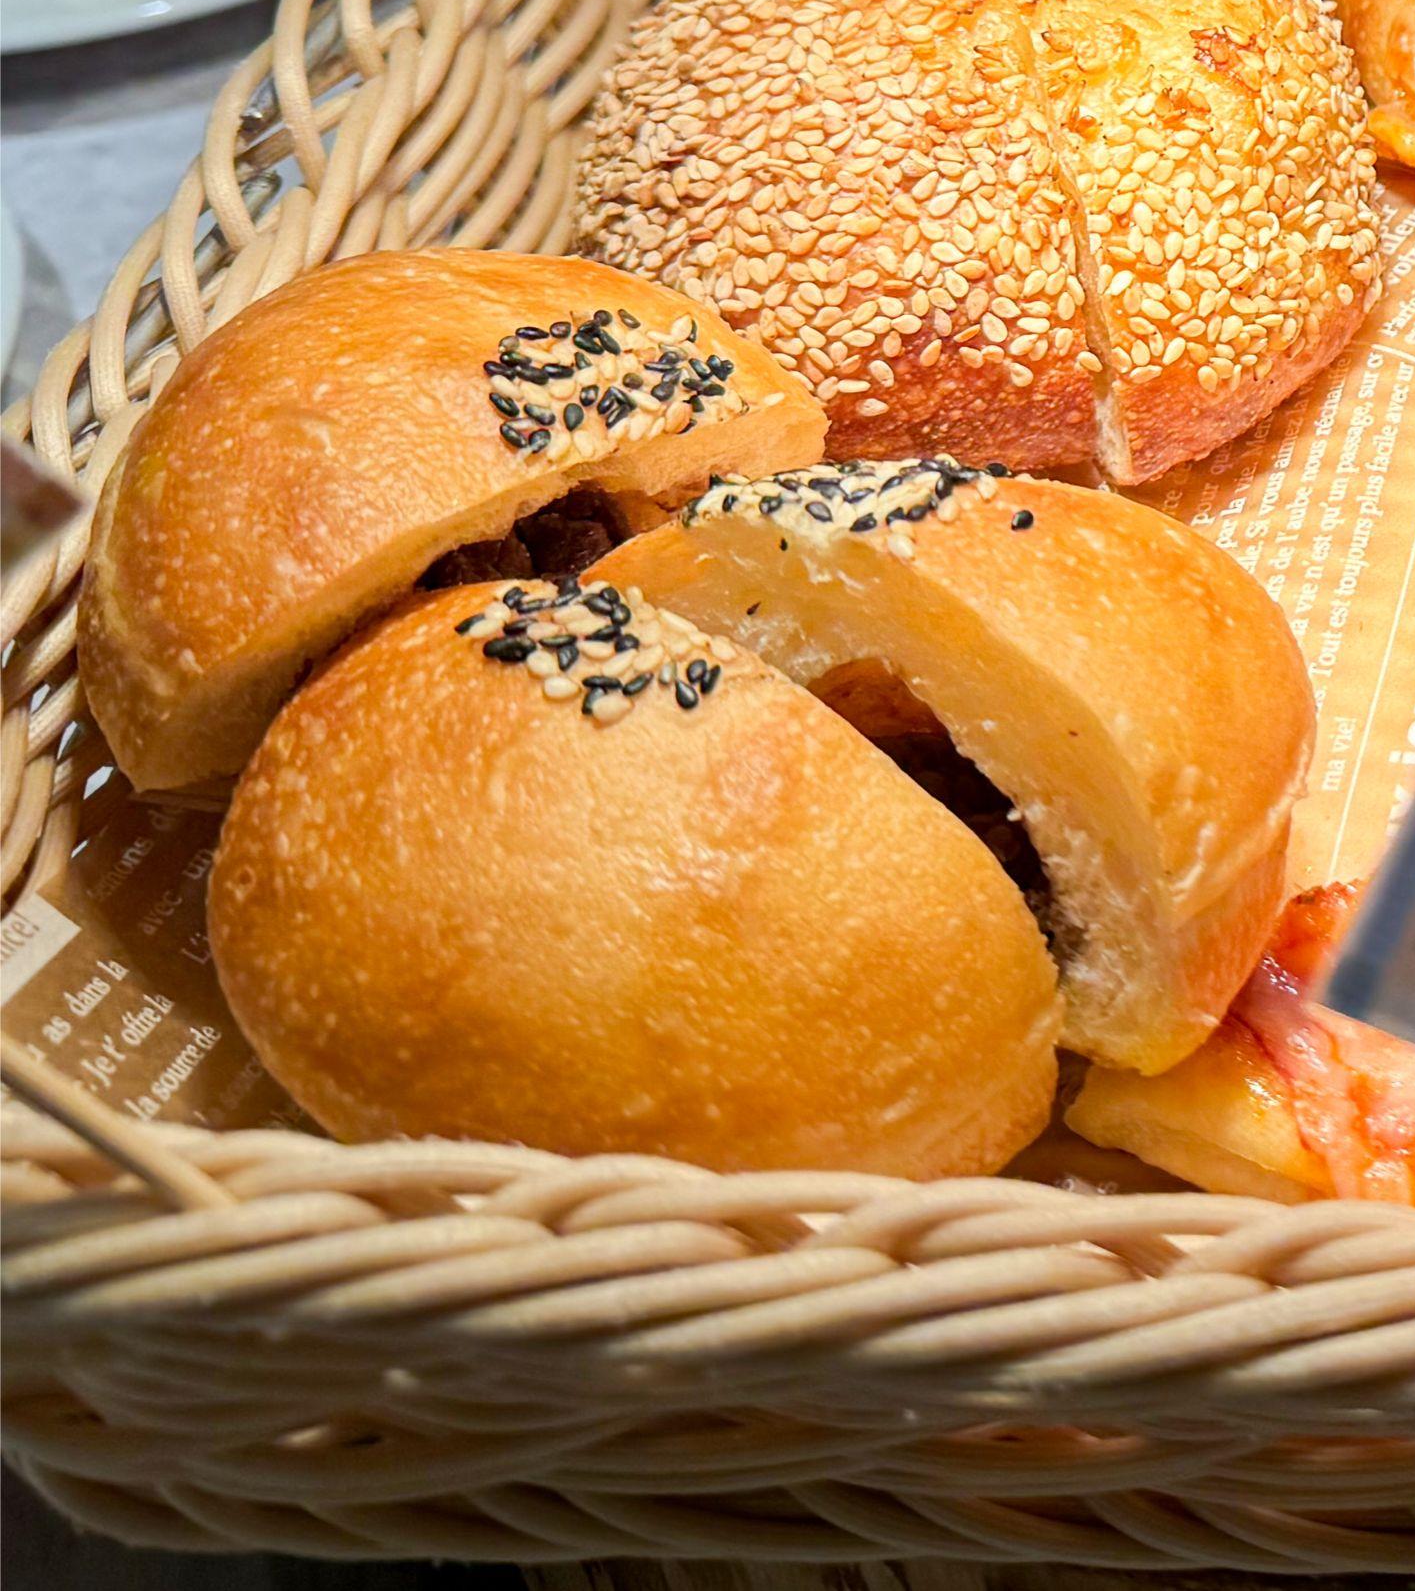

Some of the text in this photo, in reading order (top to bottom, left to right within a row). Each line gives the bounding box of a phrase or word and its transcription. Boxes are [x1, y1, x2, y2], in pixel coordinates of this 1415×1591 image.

[1300, 439, 1327, 481] nous
[1335, 402, 1377, 473] passage,
[1256, 473, 1284, 515] vous
[1310, 385, 1410, 677] Tout est toujours plus facile avec
[1320, 717, 1358, 791] ma vie!
[41, 959, 129, 1044] as dans la
[80, 1052, 117, 1087] Je
[150, 991, 175, 1019] la
[151, 1024, 221, 1099] source de
